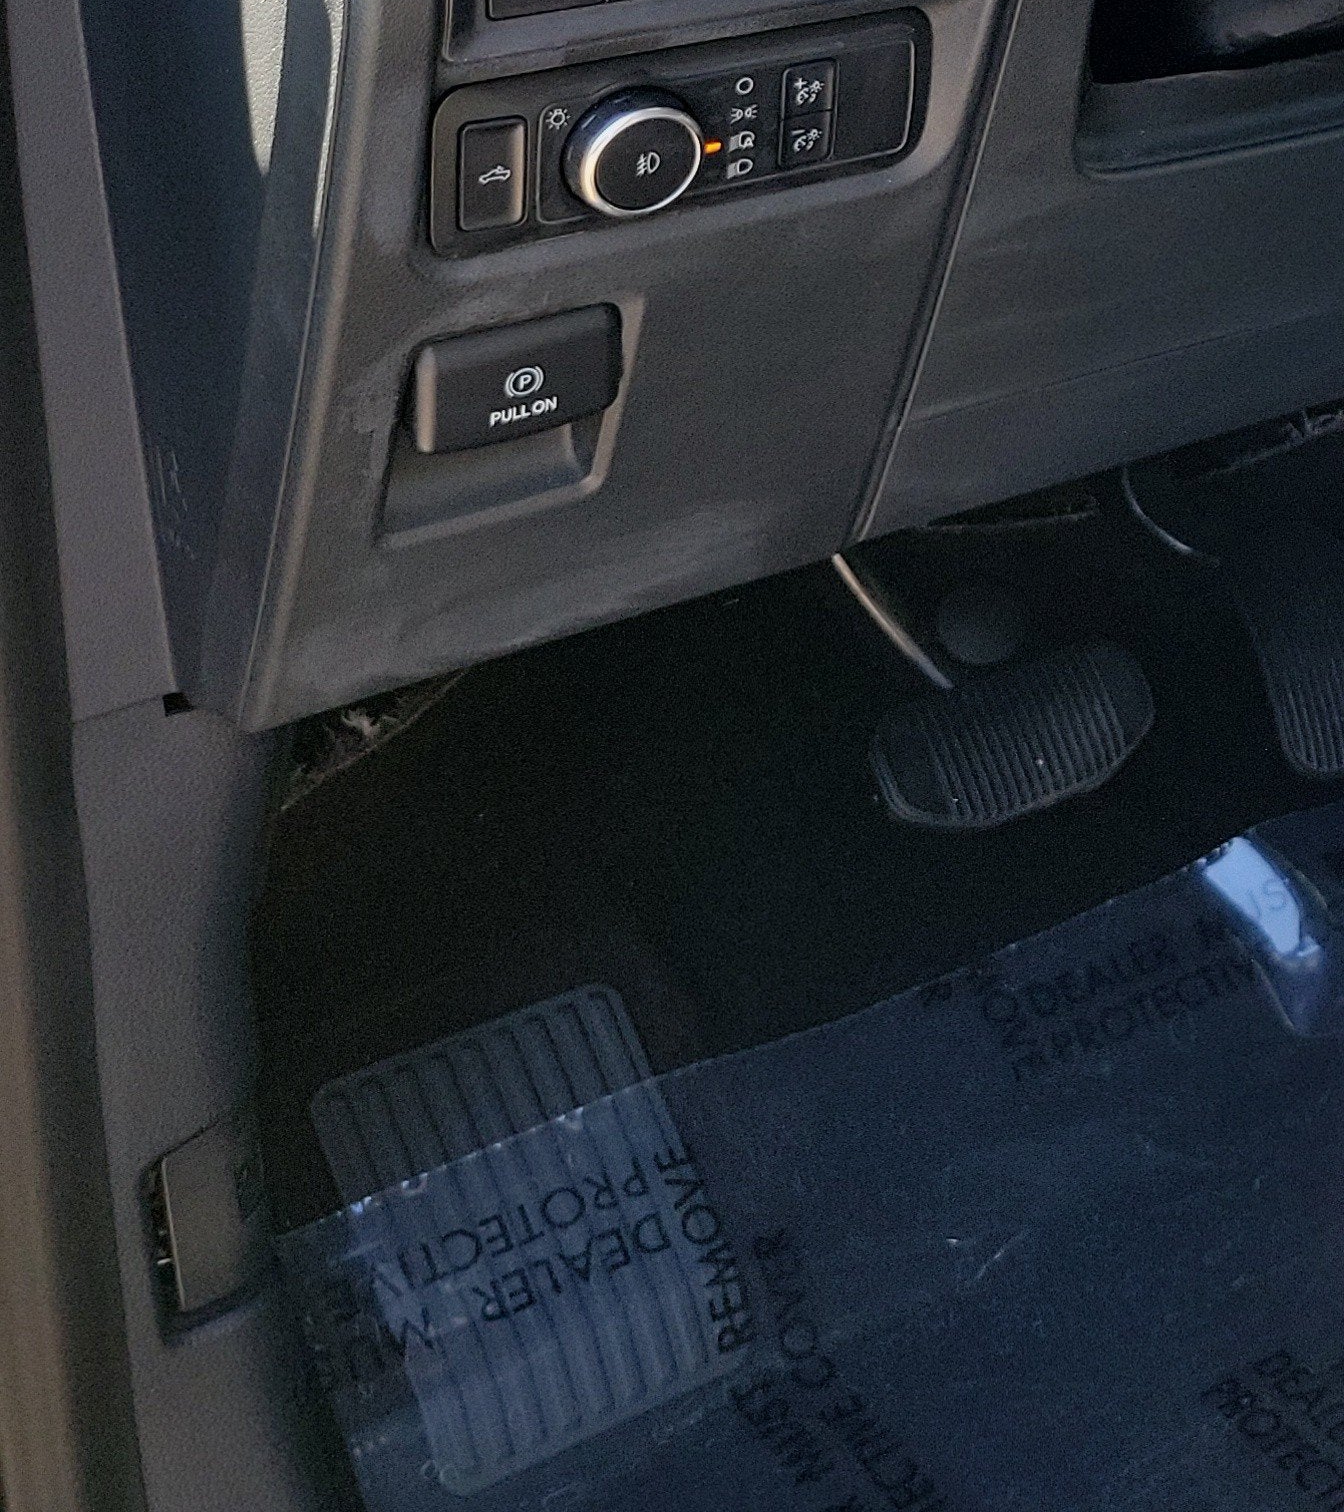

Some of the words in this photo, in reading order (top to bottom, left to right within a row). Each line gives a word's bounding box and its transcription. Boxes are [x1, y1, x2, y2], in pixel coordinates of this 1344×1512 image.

[489, 404, 531, 427] PULL
[532, 396, 558, 415] ON
[472, 1211, 671, 1323] DEALER
[654, 1145, 758, 1354] REMOVE
